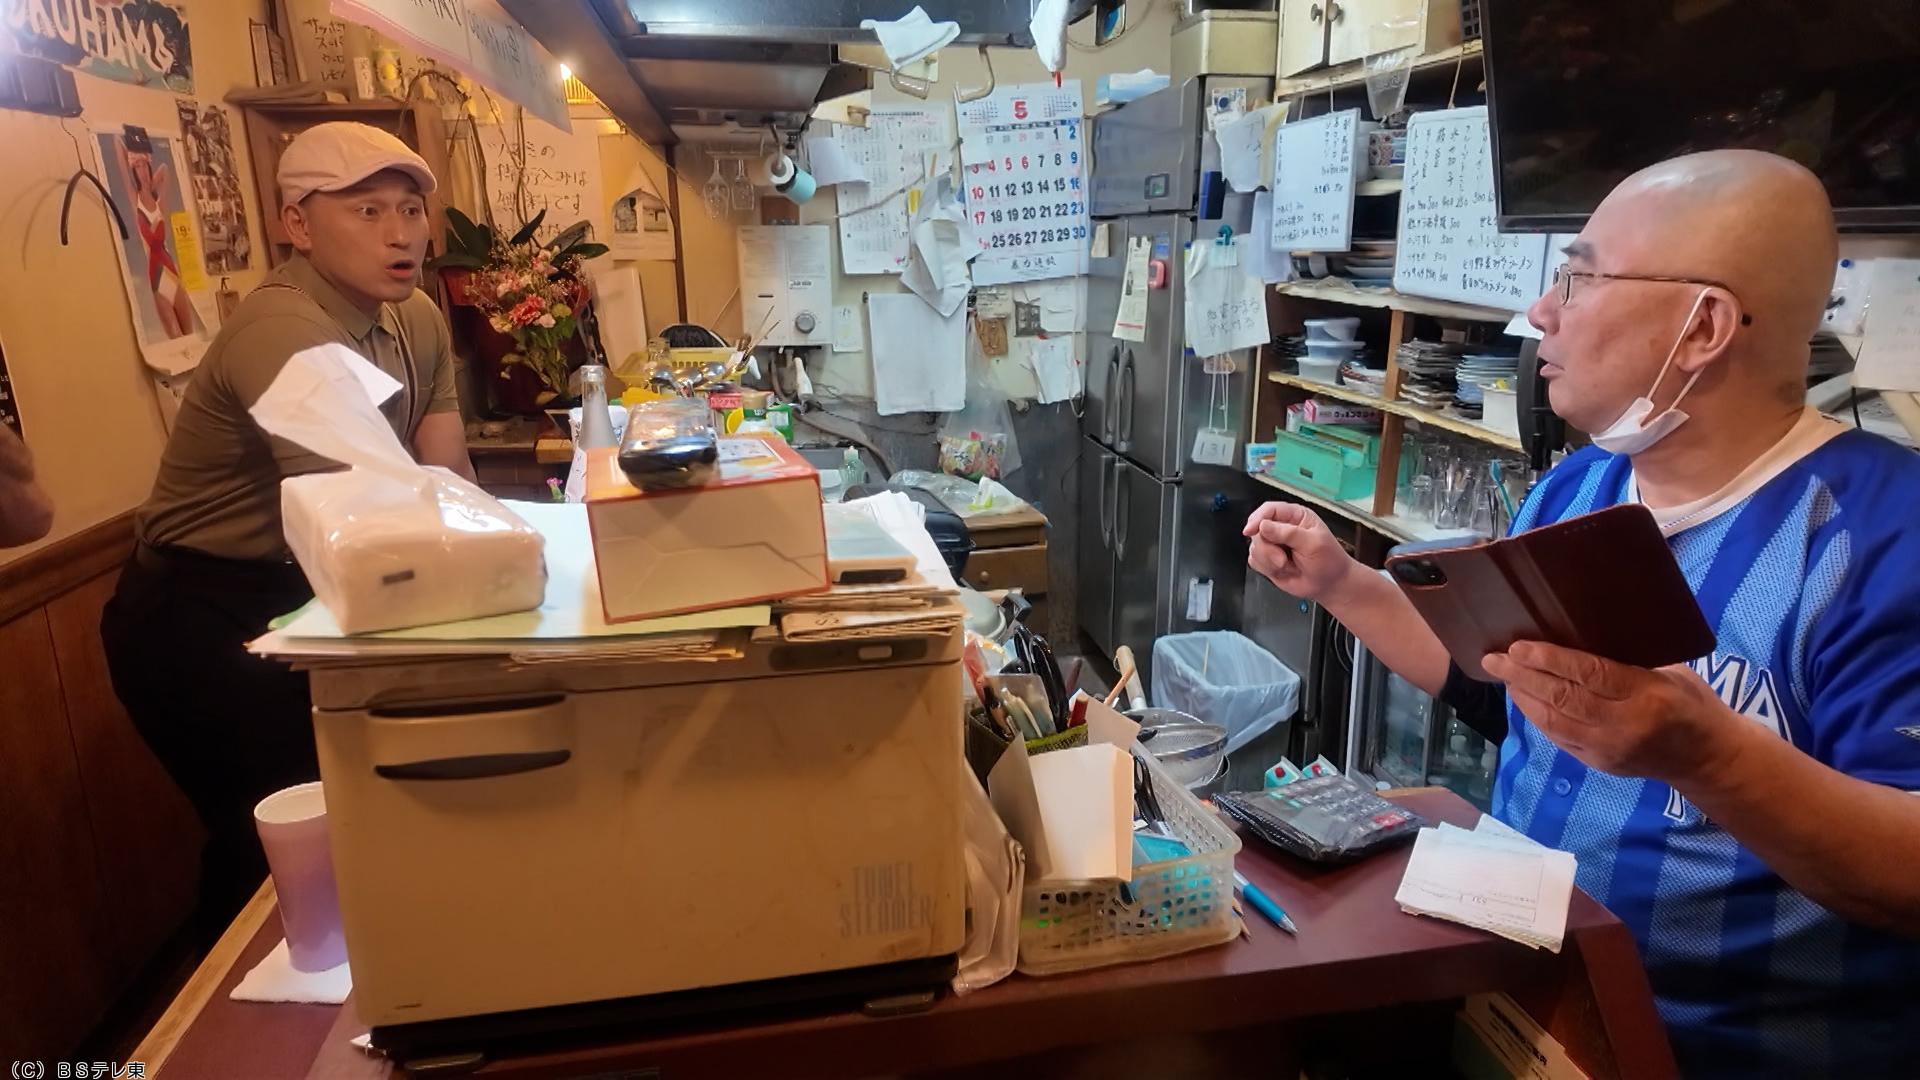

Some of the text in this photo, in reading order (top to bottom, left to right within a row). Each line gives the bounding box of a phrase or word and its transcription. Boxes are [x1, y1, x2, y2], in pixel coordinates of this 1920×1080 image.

[1013, 100, 1028, 120] 5
[1053, 128, 1059, 140] 1
[1069, 126, 1076, 140] 2
[988, 160, 996, 172] 4
[1005, 157, 1013, 171] 5
[1021, 156, 1029, 170] 6
[1037, 155, 1045, 168] 7
[1054, 153, 1062, 166] 8
[1070, 151, 1078, 164] 9
[971, 187, 984, 200] 10
[989, 185, 1000, 198] 11
[1005, 183, 1017, 196] 12
[1021, 181, 1034, 195] 13
[1037, 180, 1050, 193] 14
[1054, 178, 1066, 191] 15
[974, 201, 1084, 225] 17 18 19 20 21 22 23
[992, 235, 1006, 248] 25
[1008, 233, 1022, 246] 26
[1024, 231, 1038, 244] 27
[1040, 229, 1054, 243] 28
[1056, 228, 1070, 242] 29
[1072, 226, 1086, 240] 30
